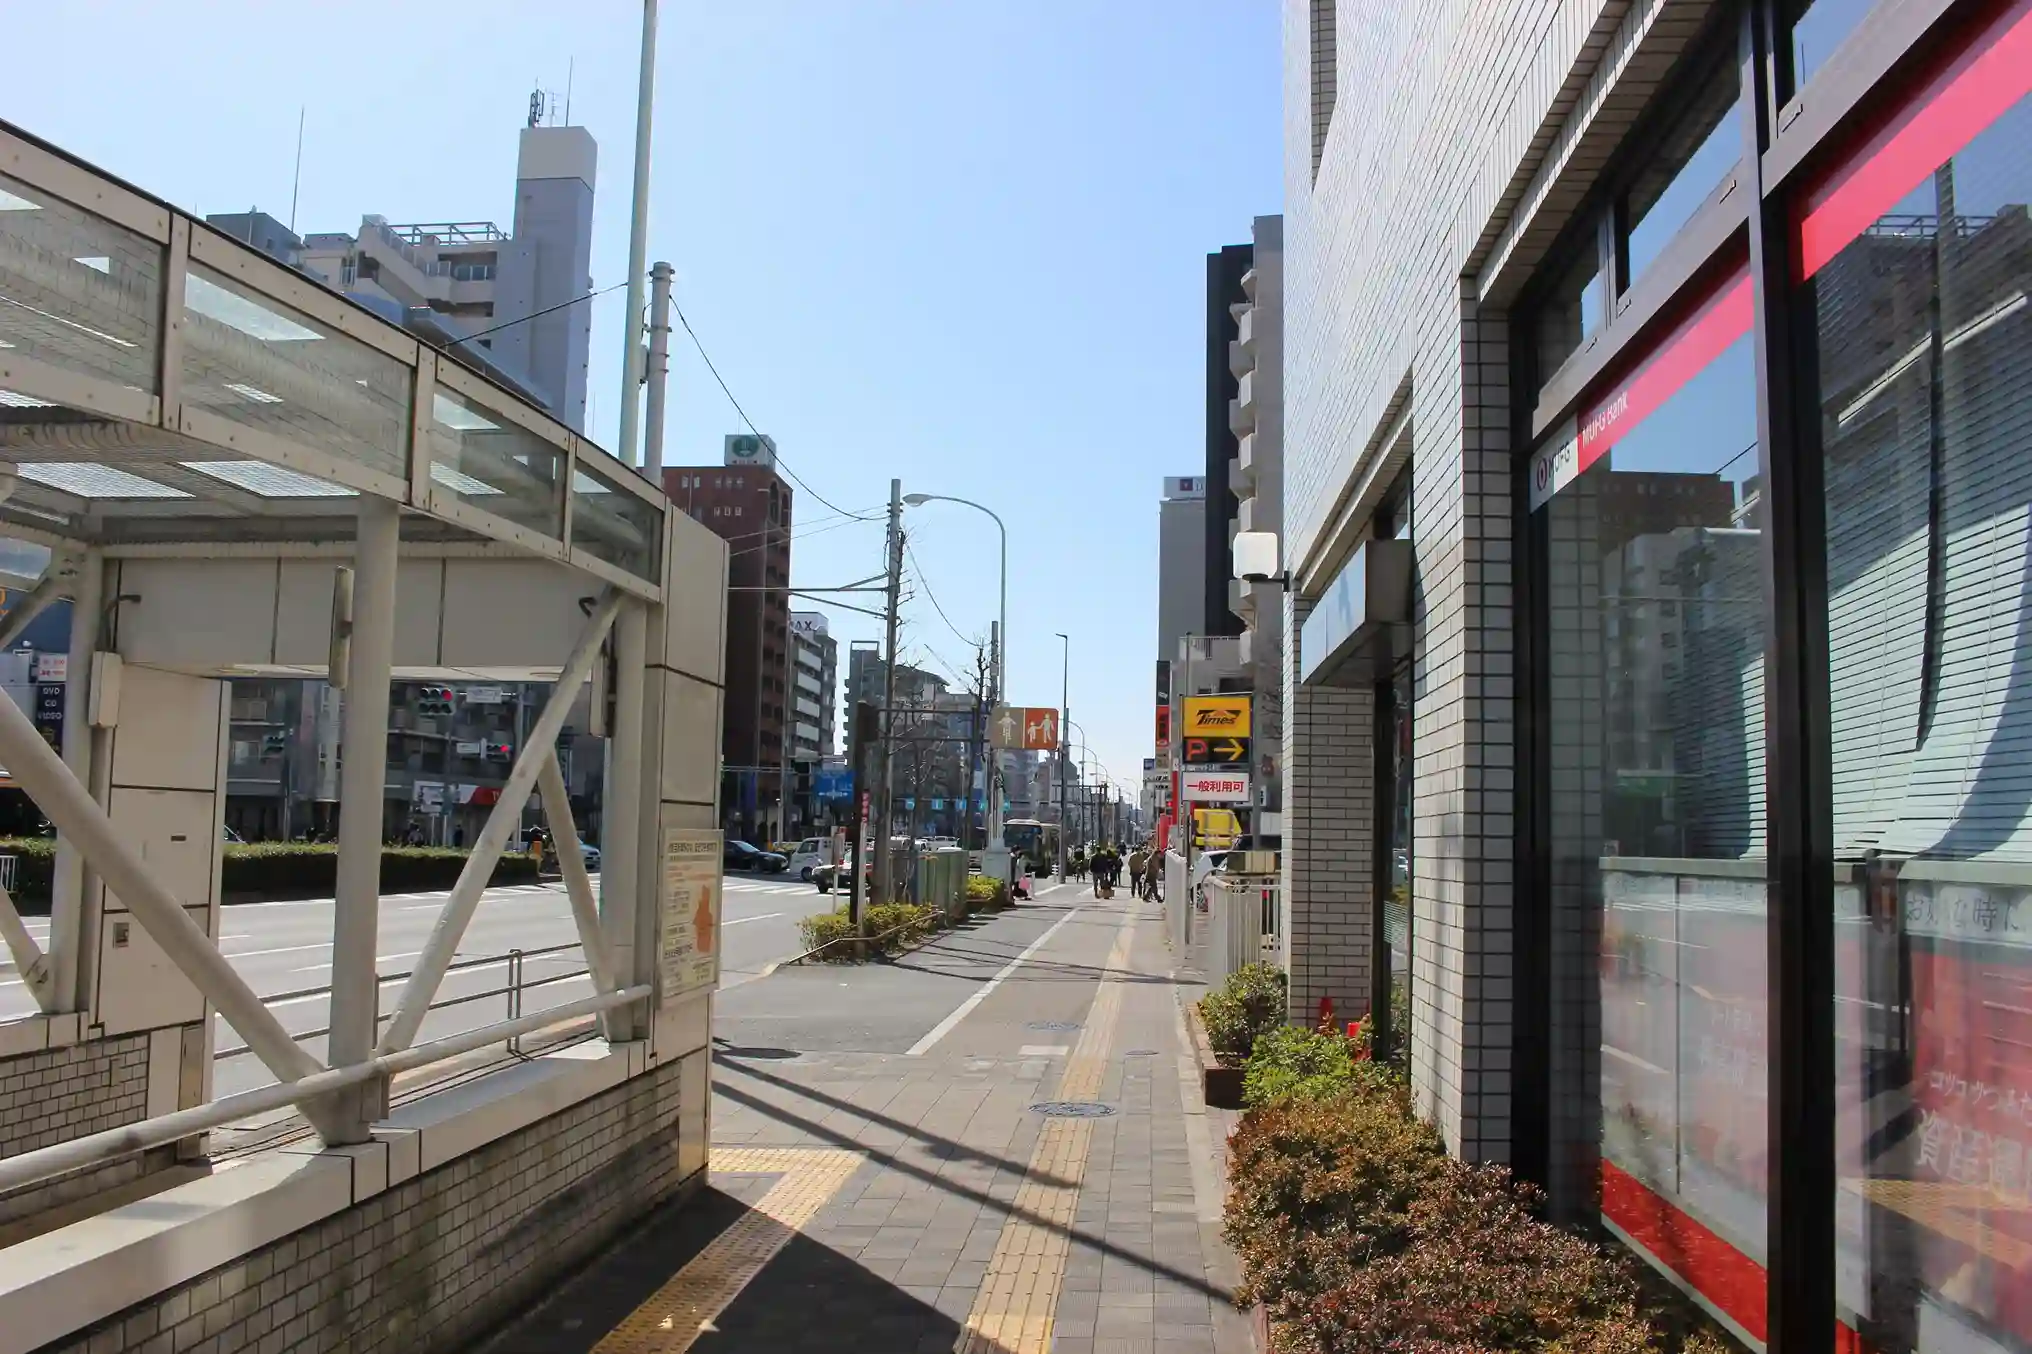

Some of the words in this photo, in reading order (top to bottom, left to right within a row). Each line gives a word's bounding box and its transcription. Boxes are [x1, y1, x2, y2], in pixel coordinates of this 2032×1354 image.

[1196, 709, 1241, 726] Times
[1186, 739, 1207, 761] P
[1187, 780, 1244, 792] 一般利用可
